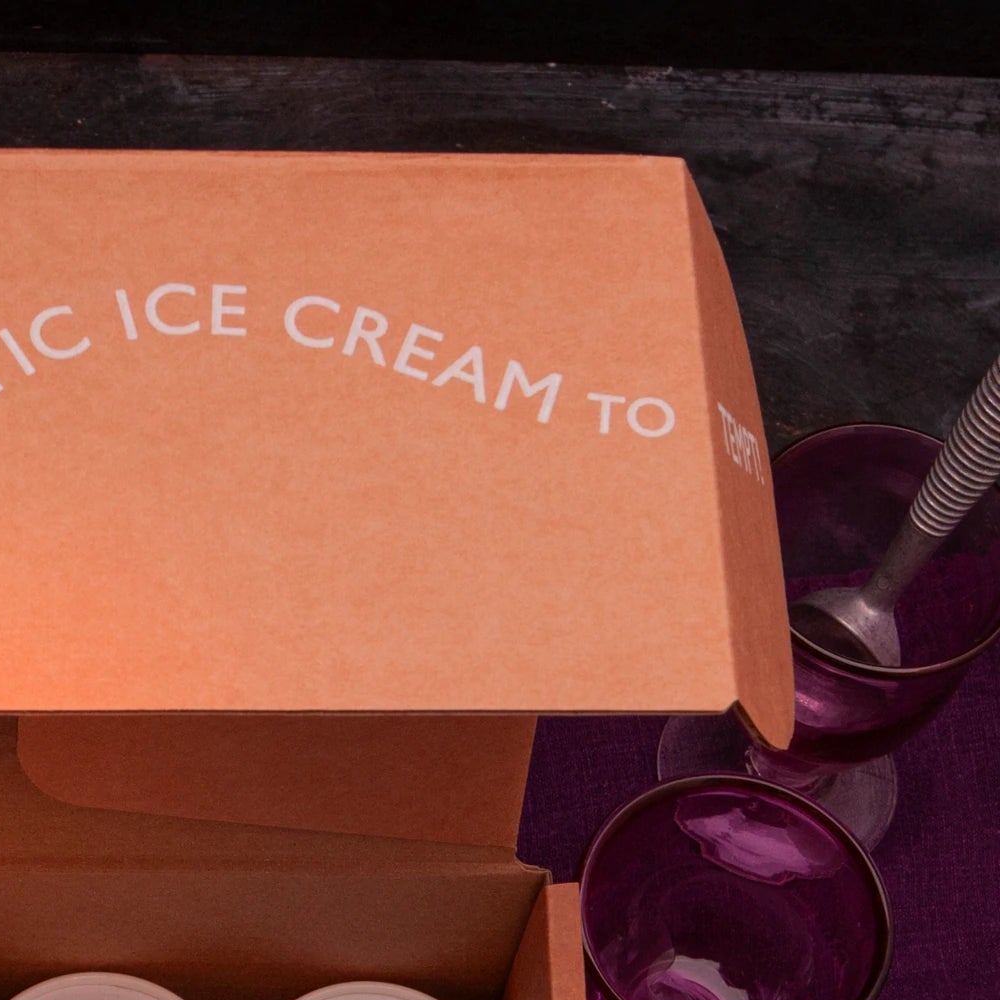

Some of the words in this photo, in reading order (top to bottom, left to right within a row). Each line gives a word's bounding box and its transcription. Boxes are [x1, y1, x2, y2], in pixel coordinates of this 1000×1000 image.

[114, 282, 248, 340] ICE
[283, 295, 563, 424] CREAM
[586, 392, 676, 438] TO
[716, 400, 766, 486] TEMPT!
